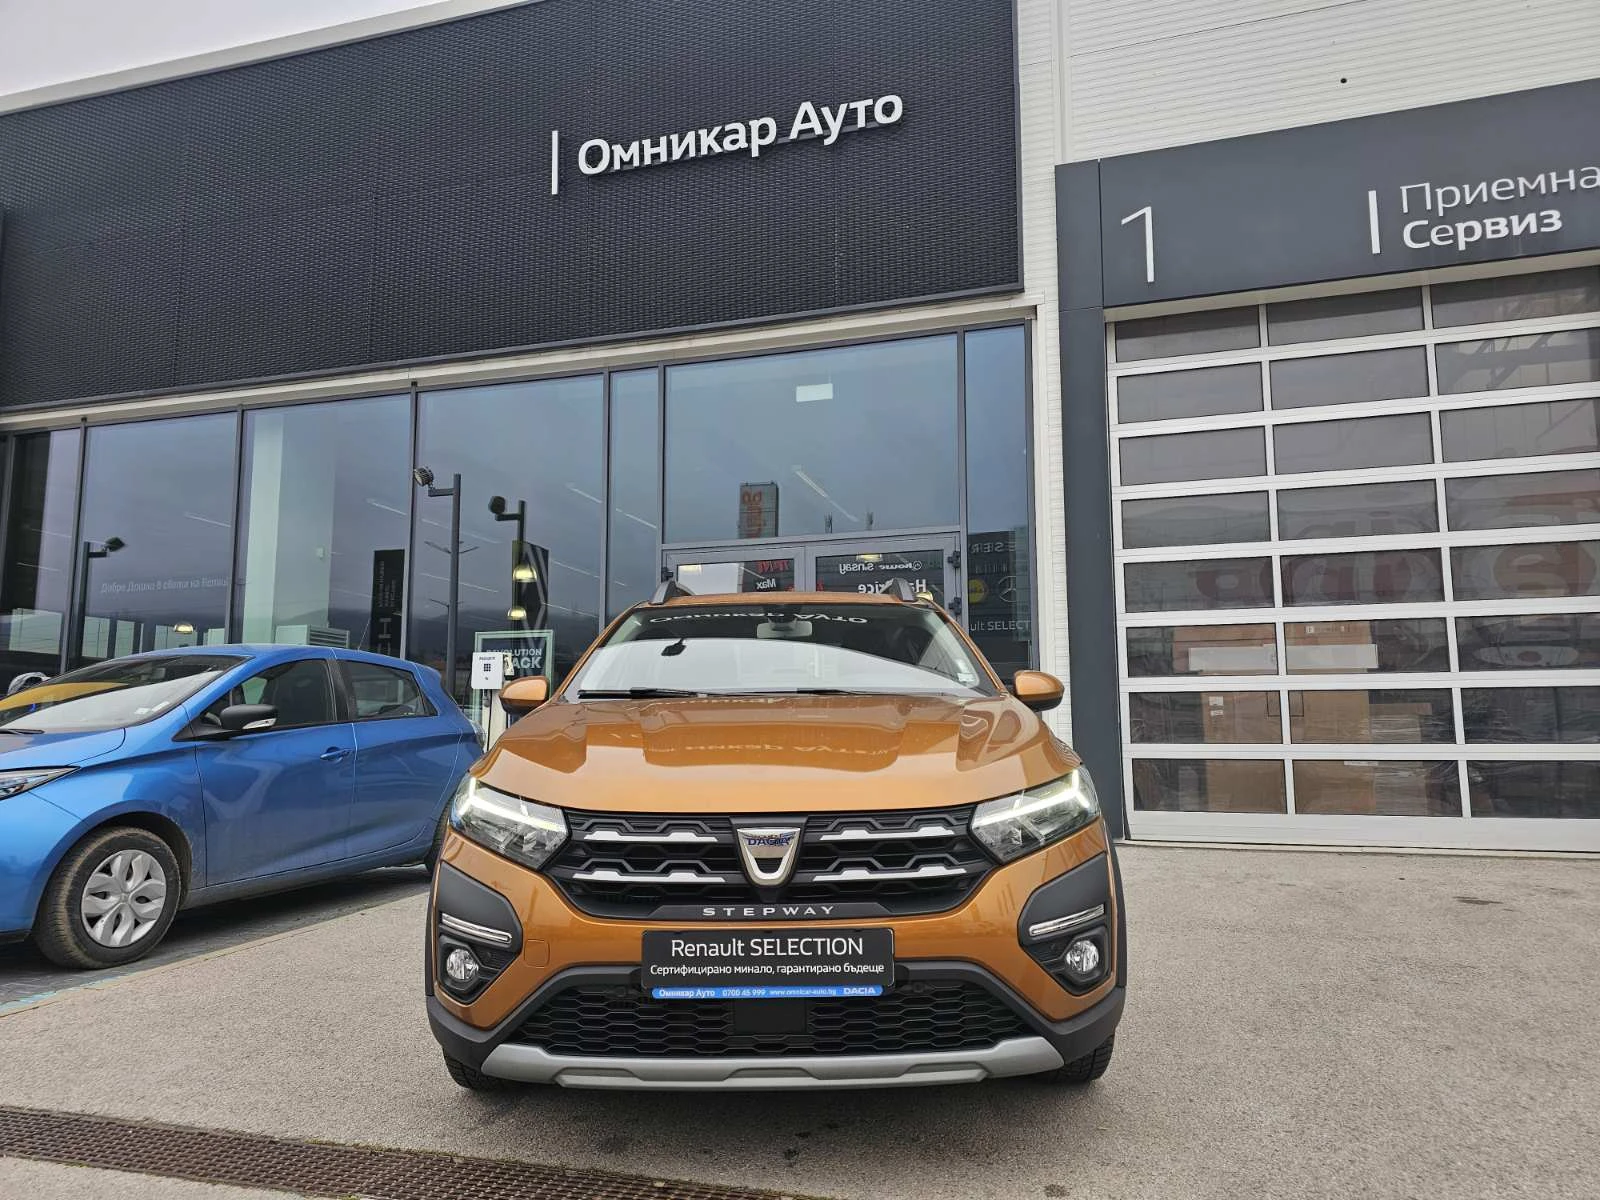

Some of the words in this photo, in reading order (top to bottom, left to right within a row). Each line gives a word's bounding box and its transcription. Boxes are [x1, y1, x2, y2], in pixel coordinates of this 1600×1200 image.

[578, 116, 777, 175] Омникар
[789, 94, 903, 145] Ауто
[1400, 166, 1600, 217] Приемна
[1403, 209, 1562, 250] Сервиз
[1121, 205, 1155, 283] 1
[512, 656, 541, 669] ACK
[702, 905, 835, 917] STEPWAY
[671, 938, 745, 957] Renault
[749, 937, 864, 956] SELECTION
[650, 964, 732, 977] Сертифицирано
[733, 964, 775, 975] минало,
[776, 963, 842, 975] гарантирано
[843, 962, 885, 974] бъдеще
[695, 989, 715, 999] Ауто
[843, 986, 876, 995] DACIA
